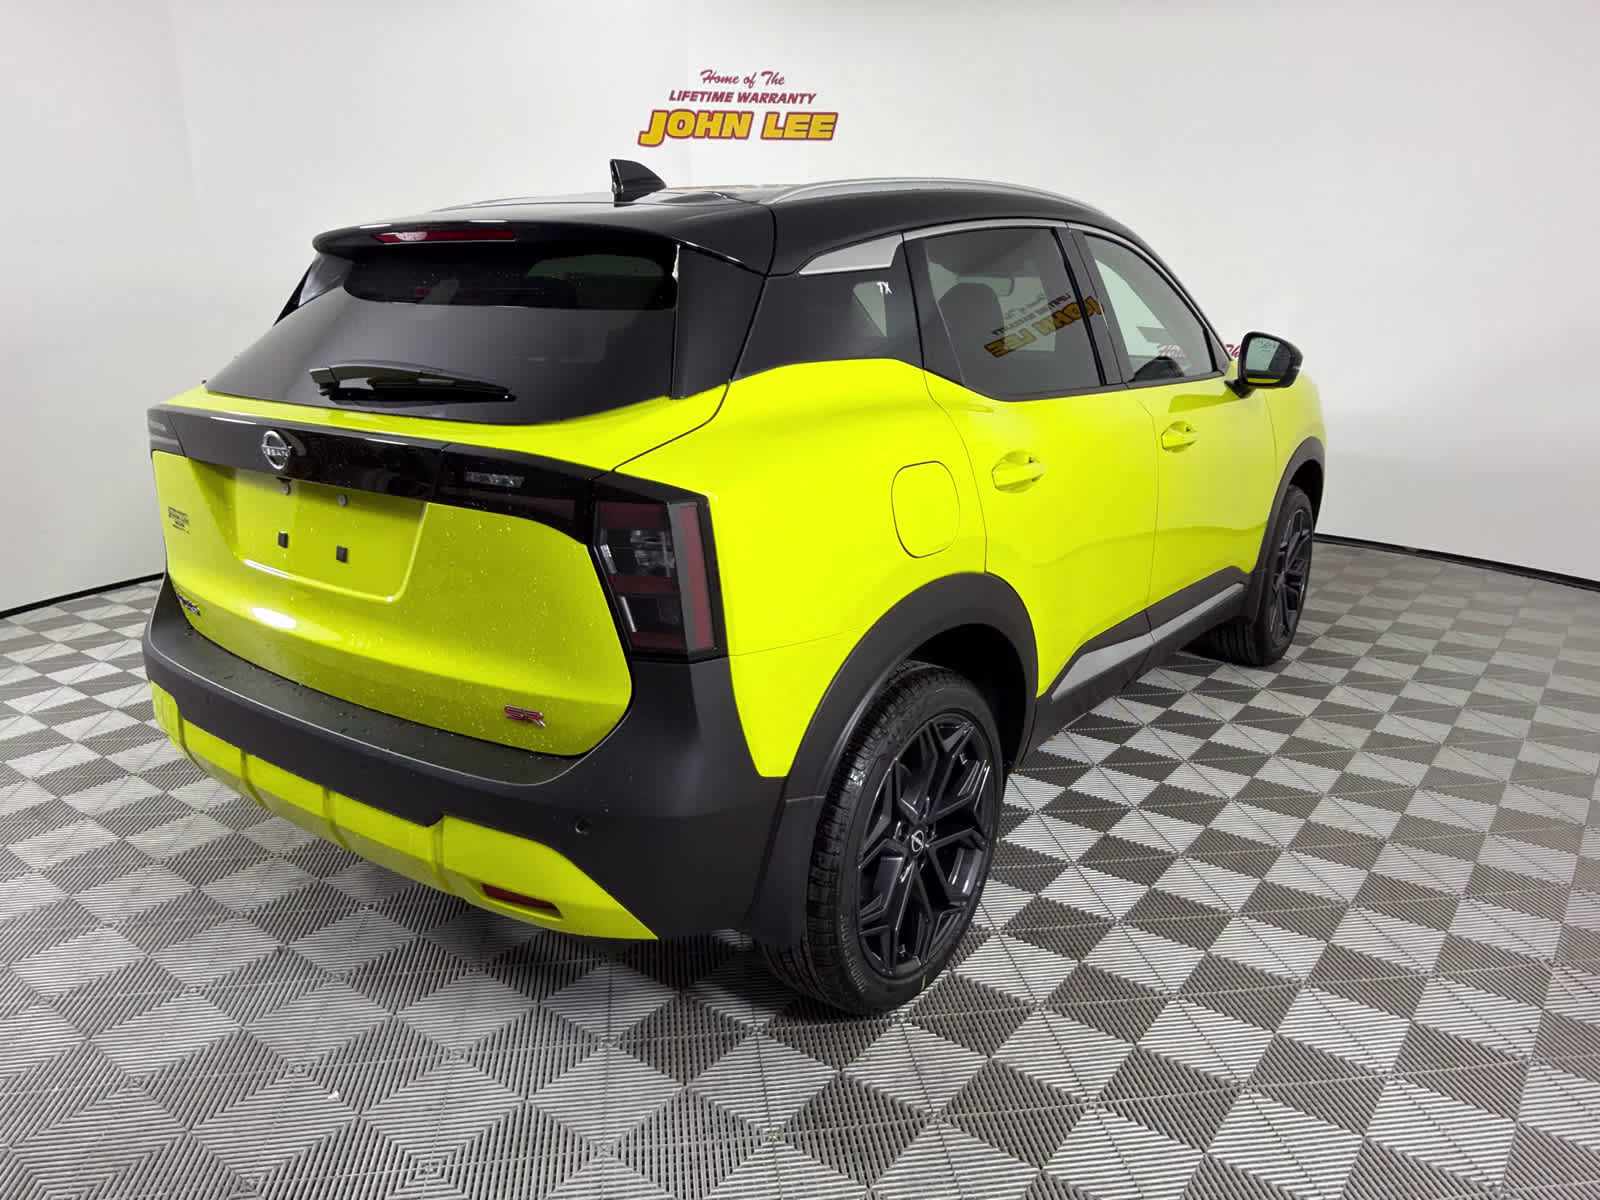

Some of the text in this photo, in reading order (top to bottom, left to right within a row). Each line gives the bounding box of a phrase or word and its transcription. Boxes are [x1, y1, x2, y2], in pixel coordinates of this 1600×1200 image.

[700, 69, 785, 88] Home of The
[668, 90, 816, 104] LIFETIME WARRANTY
[638, 109, 838, 147] JOHN LEE
[504, 704, 546, 728] SR
